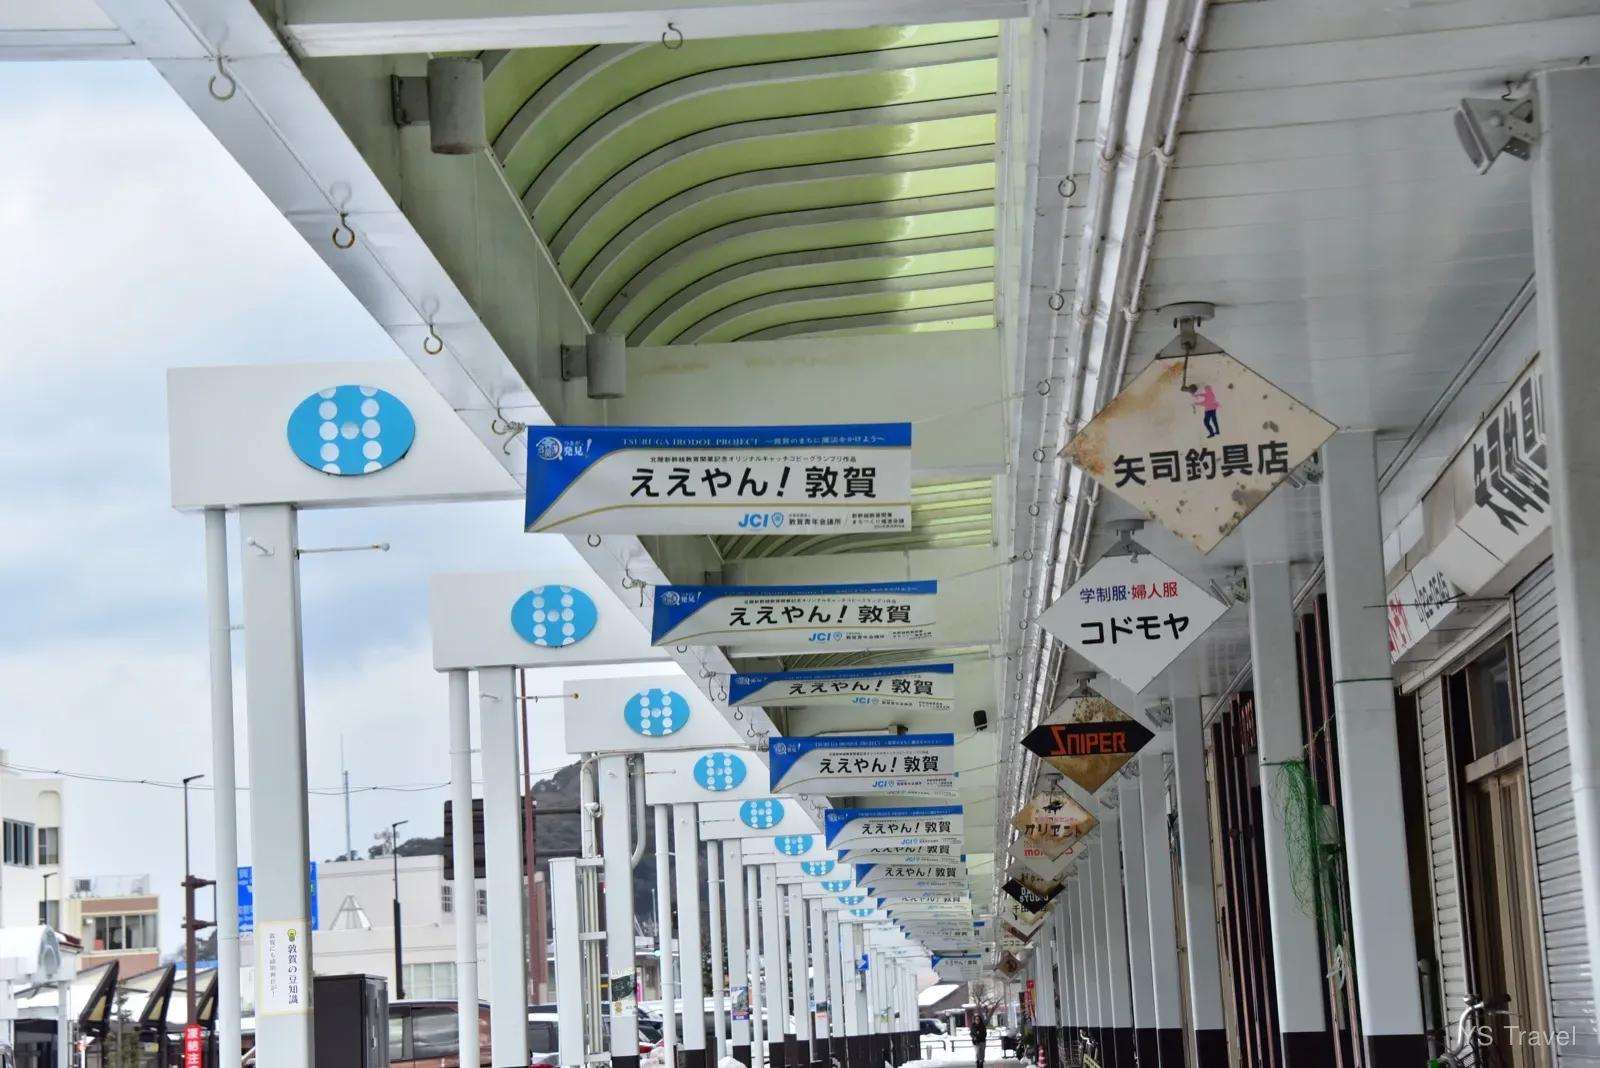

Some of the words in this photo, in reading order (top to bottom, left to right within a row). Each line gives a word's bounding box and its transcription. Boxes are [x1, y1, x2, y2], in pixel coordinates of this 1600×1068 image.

[622, 438, 670, 446] TSURUGA
[716, 437, 758, 447] PROJECT
[1113, 440, 1290, 489] 矢司釣具店
[629, 466, 877, 499] ええやん！敦賀
[738, 513, 769, 528] JCI
[729, 605, 911, 626] ええやん！敦賀
[808, 632, 831, 642] JCI
[1080, 613, 1190, 645] コドモヤ
[789, 679, 933, 696] ええやん！敦賀
[852, 697, 871, 705] JCI
[820, 756, 939, 774] ええやん！敦賀
[872, 780, 888, 788] JCI
[861, 820, 951, 835] ええやん！敦賀
[287, 943, 299, 1005] 敦賀の豆知識
